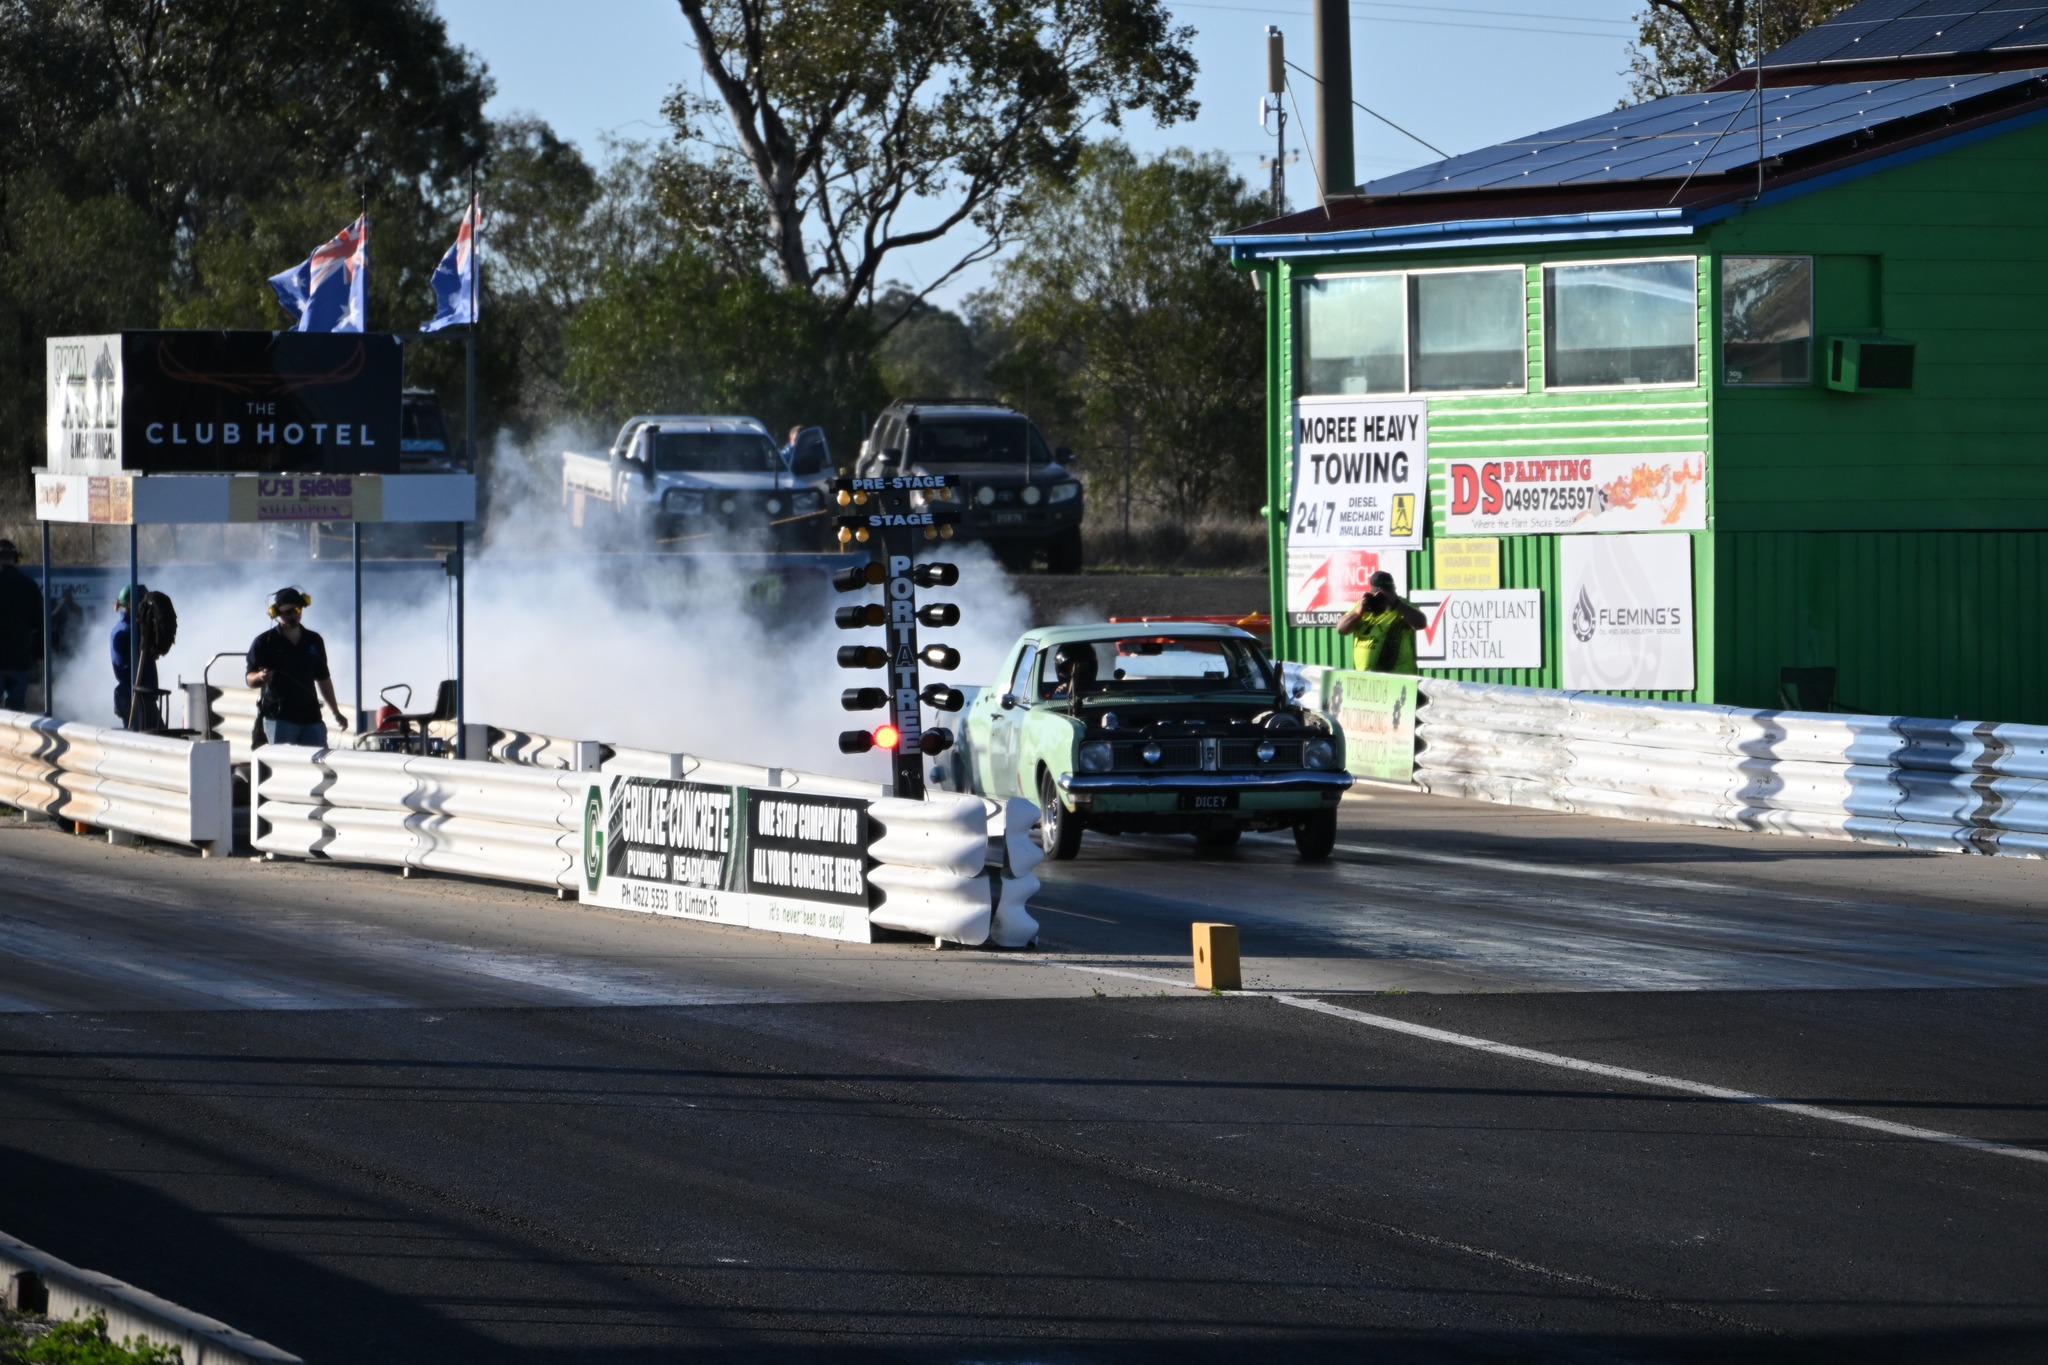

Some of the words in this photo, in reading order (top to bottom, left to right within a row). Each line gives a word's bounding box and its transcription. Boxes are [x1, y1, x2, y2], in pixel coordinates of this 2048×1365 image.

[247, 402, 275, 415] THE
[145, 422, 240, 444] CLUB
[257, 423, 375, 445] HOTEL
[1300, 417, 1357, 444] MOREE
[1364, 414, 1419, 442] HEAVY
[1311, 451, 1409, 485] TOWING
[258, 478, 294, 497] KJ'S
[299, 477, 353, 497] SIGNS
[852, 476, 945, 490] PRE-STAGE
[1451, 462, 1503, 515] DS
[1503, 459, 1592, 482] PAINTING
[1349, 497, 1378, 507] DIESEL
[1504, 486, 1594, 511] 0499725597
[869, 513, 934, 527] STAGE
[1296, 500, 1336, 537] 24/7
[1340, 511, 1385, 522] MECHANIC
[1498, 519, 1508, 528] the
[1530, 517, 1552, 528] Sticks
[1339, 525, 1384, 536] AVAILABLE
[1296, 613, 1317, 624] CALL
[1451, 600, 1537, 619] COMPLIANT
[1600, 607, 1681, 625] FLEMING'S
[1452, 620, 1492, 639] ASSET
[1452, 640, 1506, 659] RENTAL
[1195, 796, 1227, 807] DICEY
[622, 783, 668, 846] GRULKE
[669, 788, 730, 853] CONCRETE
[758, 800, 776, 836] ONE
[776, 801, 798, 838] STOP
[798, 804, 840, 843] COMPANY
[840, 808, 858, 845] FOR
[627, 850, 667, 879] PUMPING
[753, 848, 767, 884] ALL
[767, 849, 790, 886] YOUR
[791, 852, 834, 891] CONCRETE
[835, 857, 863, 896] NEEDS
[622, 883, 631, 905] Ph
[633, 885, 649, 907] 4622
[651, 888, 668, 910] 5533
[674, 890, 683, 912] 18
[685, 891, 708, 916] Linton
[782, 908, 800, 924] never
[803, 905, 817, 926] been
[819, 912, 826, 928] so
